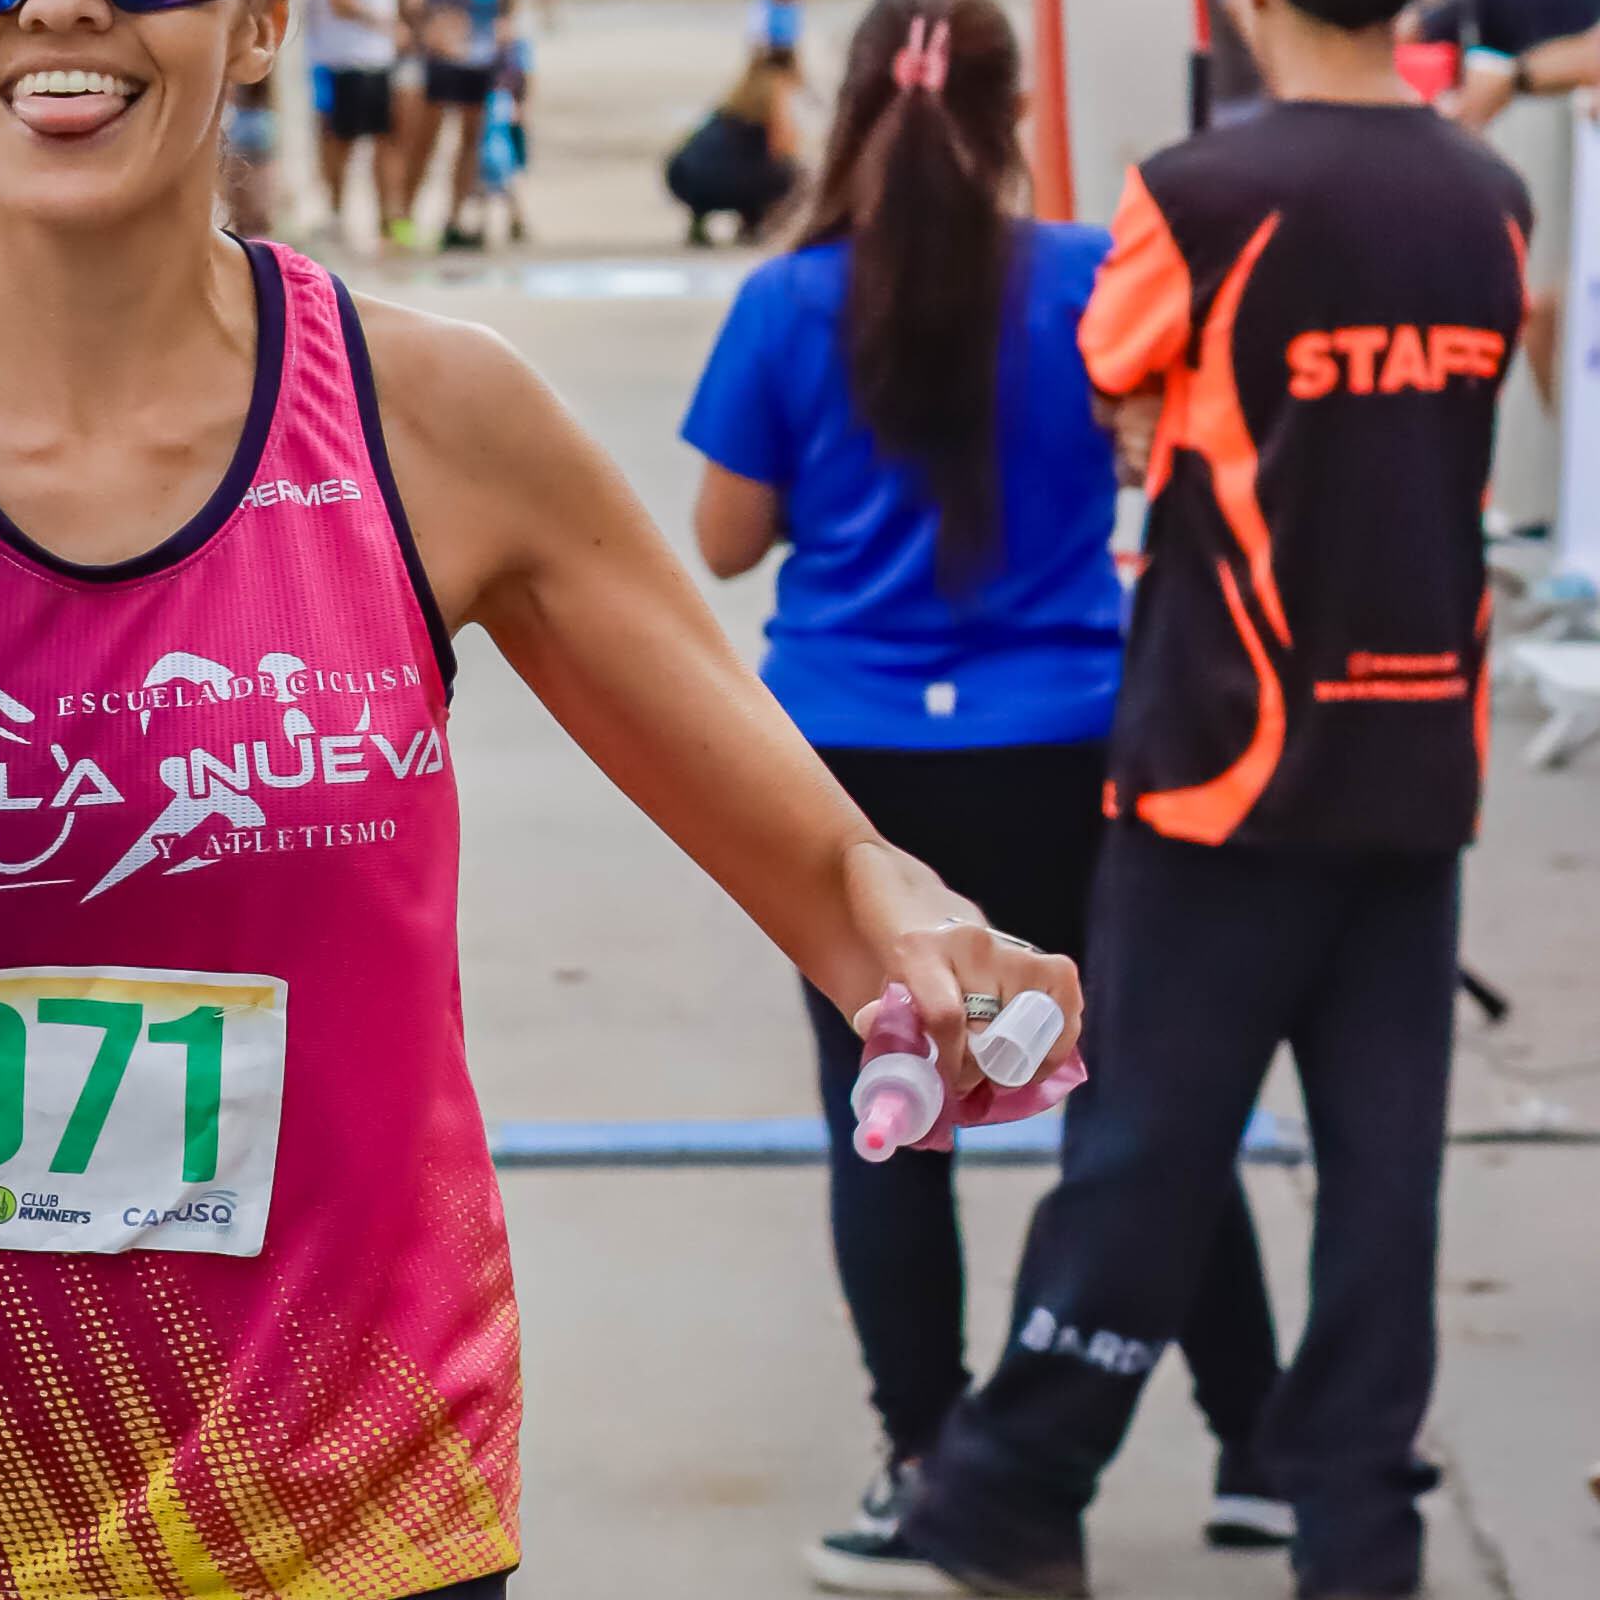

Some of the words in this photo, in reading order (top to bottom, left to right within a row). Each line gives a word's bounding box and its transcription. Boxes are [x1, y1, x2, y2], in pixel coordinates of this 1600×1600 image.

[1285, 324, 1505, 399] STAFF
[56, 682, 217, 717] ESCUELA
[231, 671, 276, 699] DE
[188, 727, 444, 797] NUEVA
[155, 837, 177, 860] Y
[203, 818, 398, 857] ATLETISMO
[18, 1206, 92, 1225] RUNNER'S
[21, 1192, 59, 1208] CLUB
